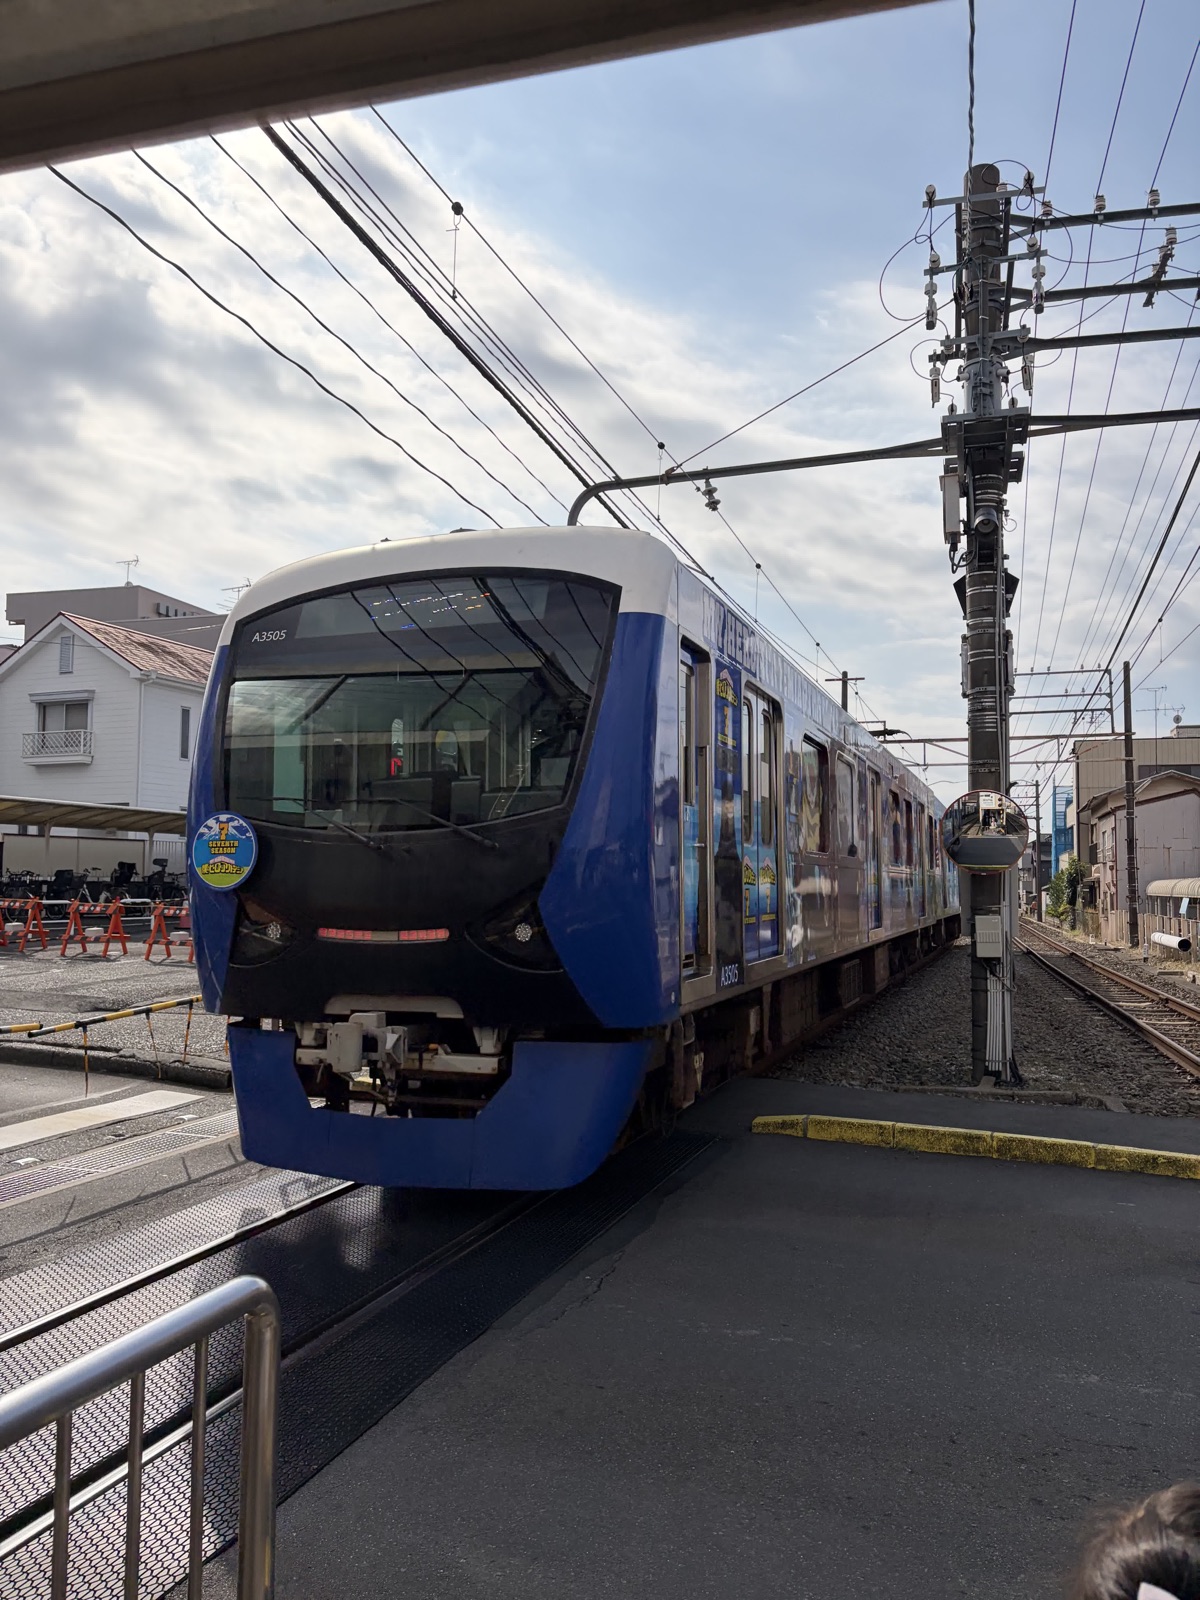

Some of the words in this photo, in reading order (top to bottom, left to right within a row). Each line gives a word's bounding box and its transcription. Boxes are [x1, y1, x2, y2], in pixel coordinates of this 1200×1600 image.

[251, 630, 287, 642] A3505
[727, 609, 757, 675] HERO
[218, 822, 229, 841] 7
[208, 840, 239, 848] SEVENTH
[210, 847, 236, 855] SEASON
[720, 964, 739, 987] A3505
